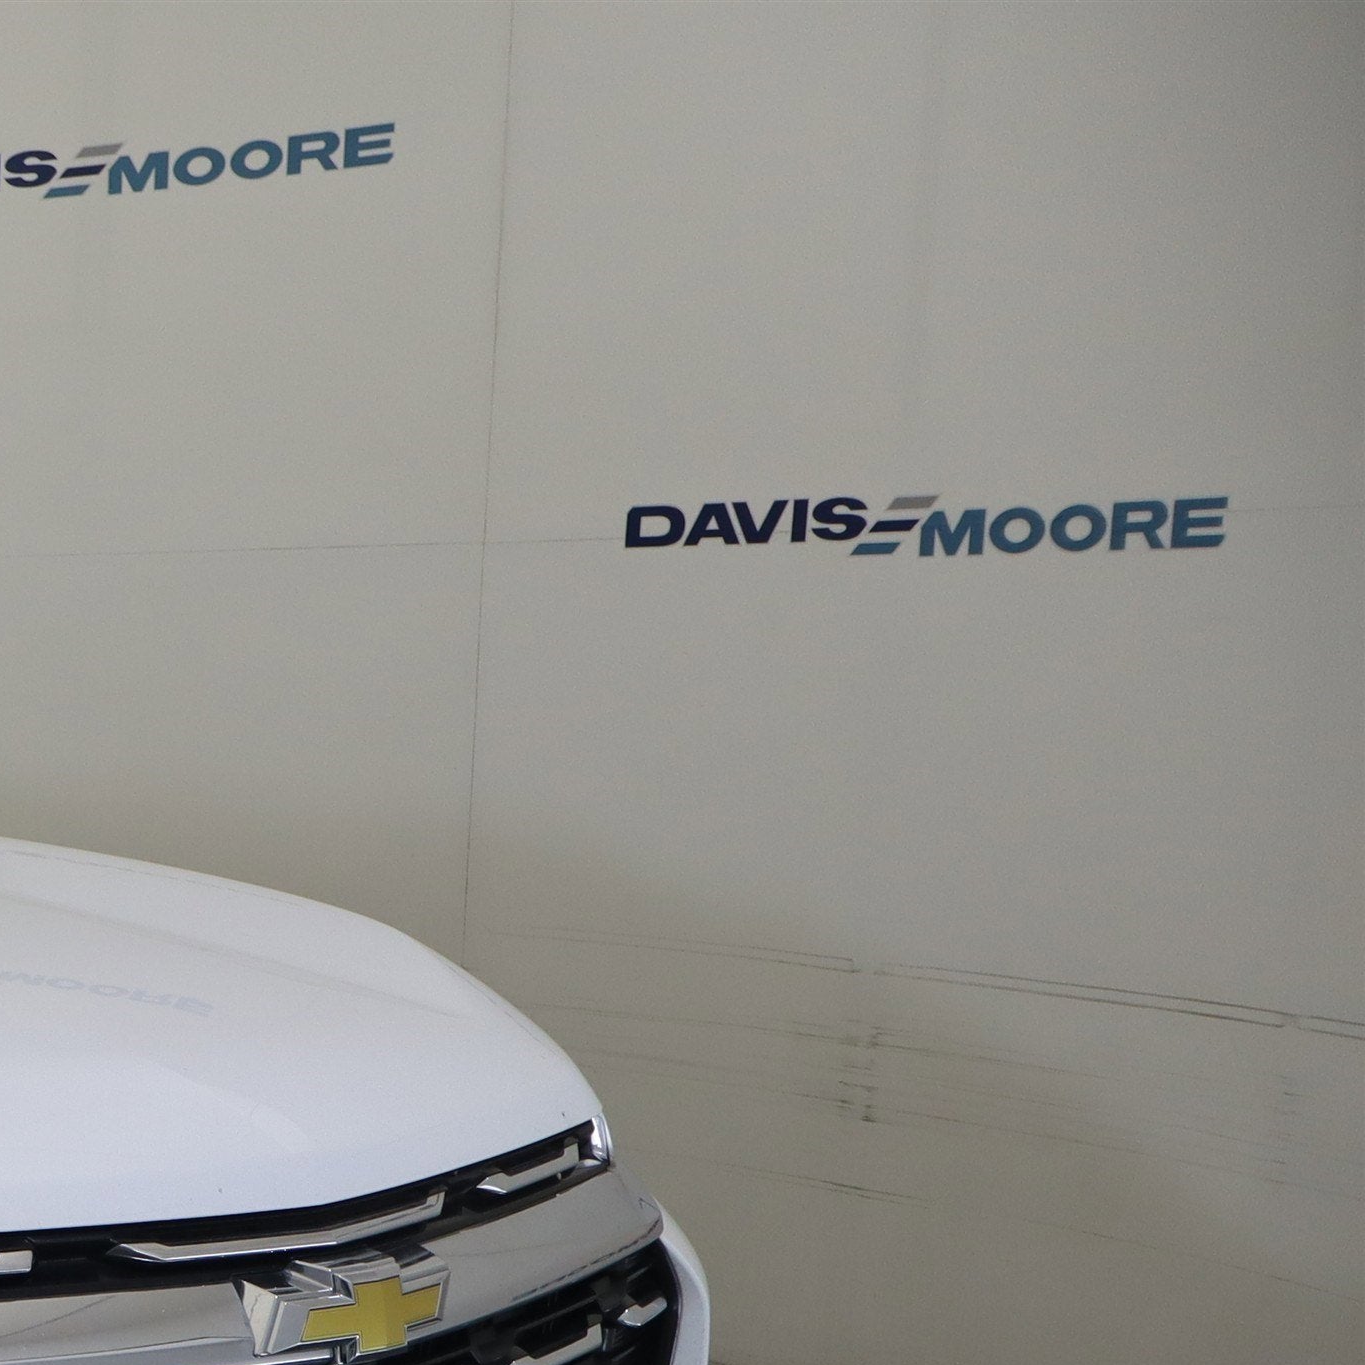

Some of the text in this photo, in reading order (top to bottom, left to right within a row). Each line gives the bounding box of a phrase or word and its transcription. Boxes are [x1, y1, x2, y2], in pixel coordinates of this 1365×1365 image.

[107, 122, 395, 195] MOORE
[625, 496, 1229, 557] DAVIS MOORE
